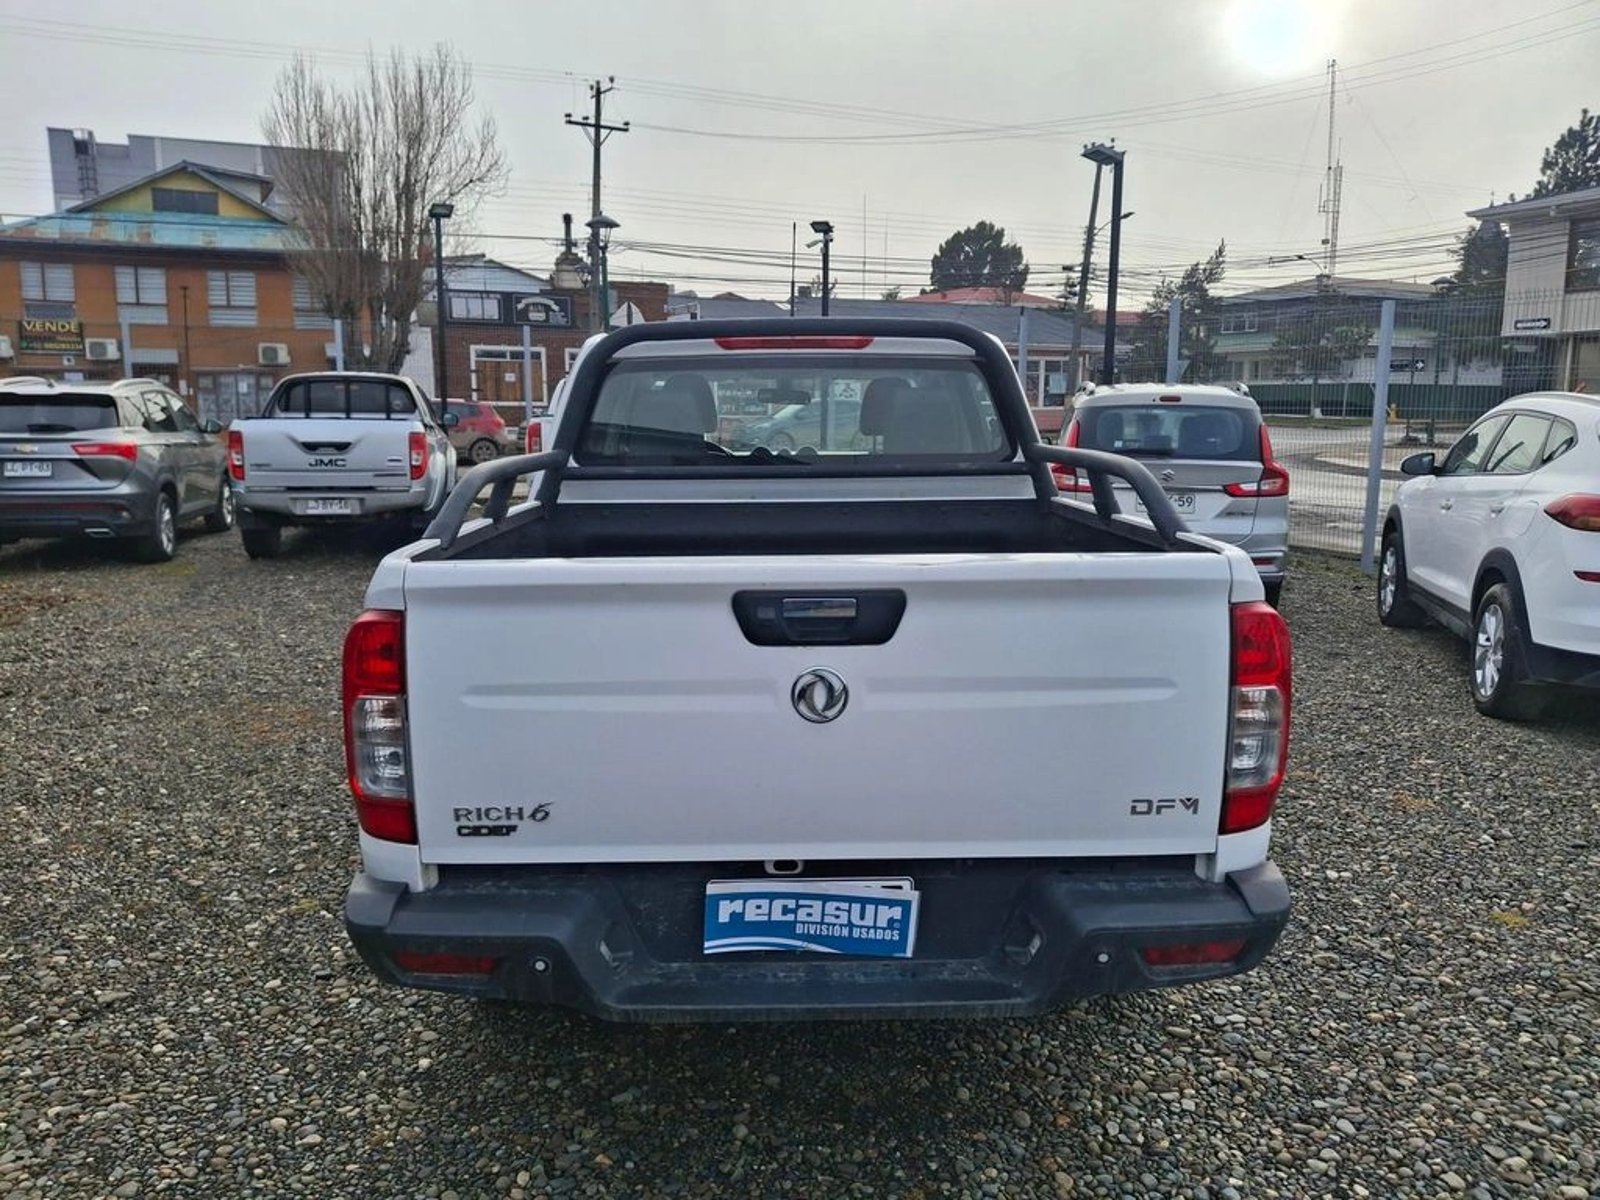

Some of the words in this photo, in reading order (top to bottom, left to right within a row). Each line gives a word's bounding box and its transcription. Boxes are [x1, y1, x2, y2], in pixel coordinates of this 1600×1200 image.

[23, 320, 79, 333] VENDE
[308, 458, 347, 468] JMC
[453, 807, 524, 822] RICH
[1130, 798, 1199, 815] DFM
[718, 898, 902, 927] recasur
[796, 922, 849, 938] DIVISIÓN
[852, 927, 899, 940] USADOS
